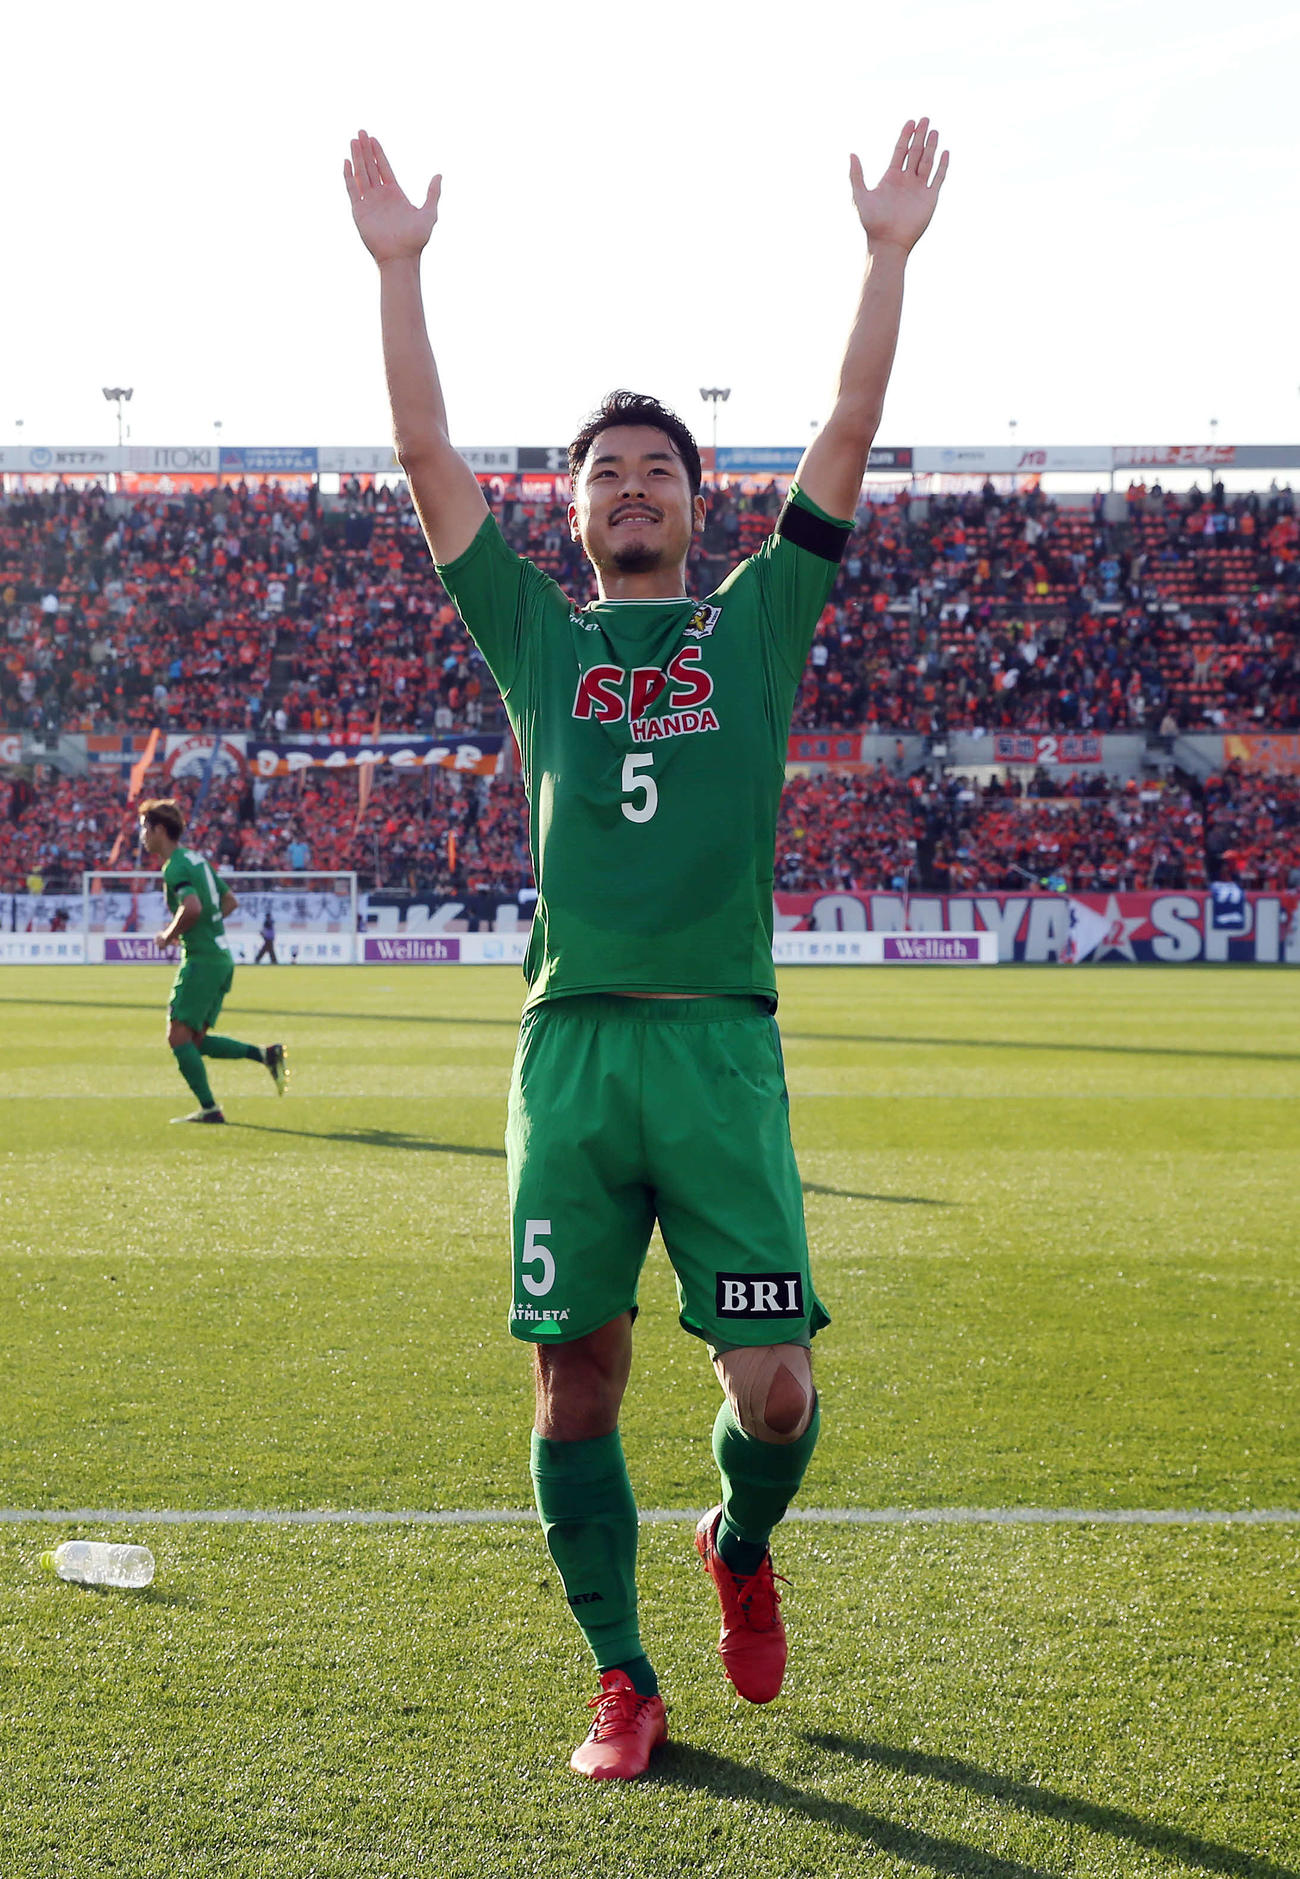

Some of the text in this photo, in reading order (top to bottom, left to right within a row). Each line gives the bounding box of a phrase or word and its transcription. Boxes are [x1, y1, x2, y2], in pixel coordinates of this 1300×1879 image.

[154, 448, 212, 467] ITOKI
[572, 645, 714, 724] ISPS
[629, 707, 720, 743] HANDA
[1037, 736, 1058, 763] 2
[621, 752, 659, 823] 5
[1151, 896, 1300, 963] SPI
[521, 1219, 556, 1297] 5
[721, 1279, 800, 1312] BRI
